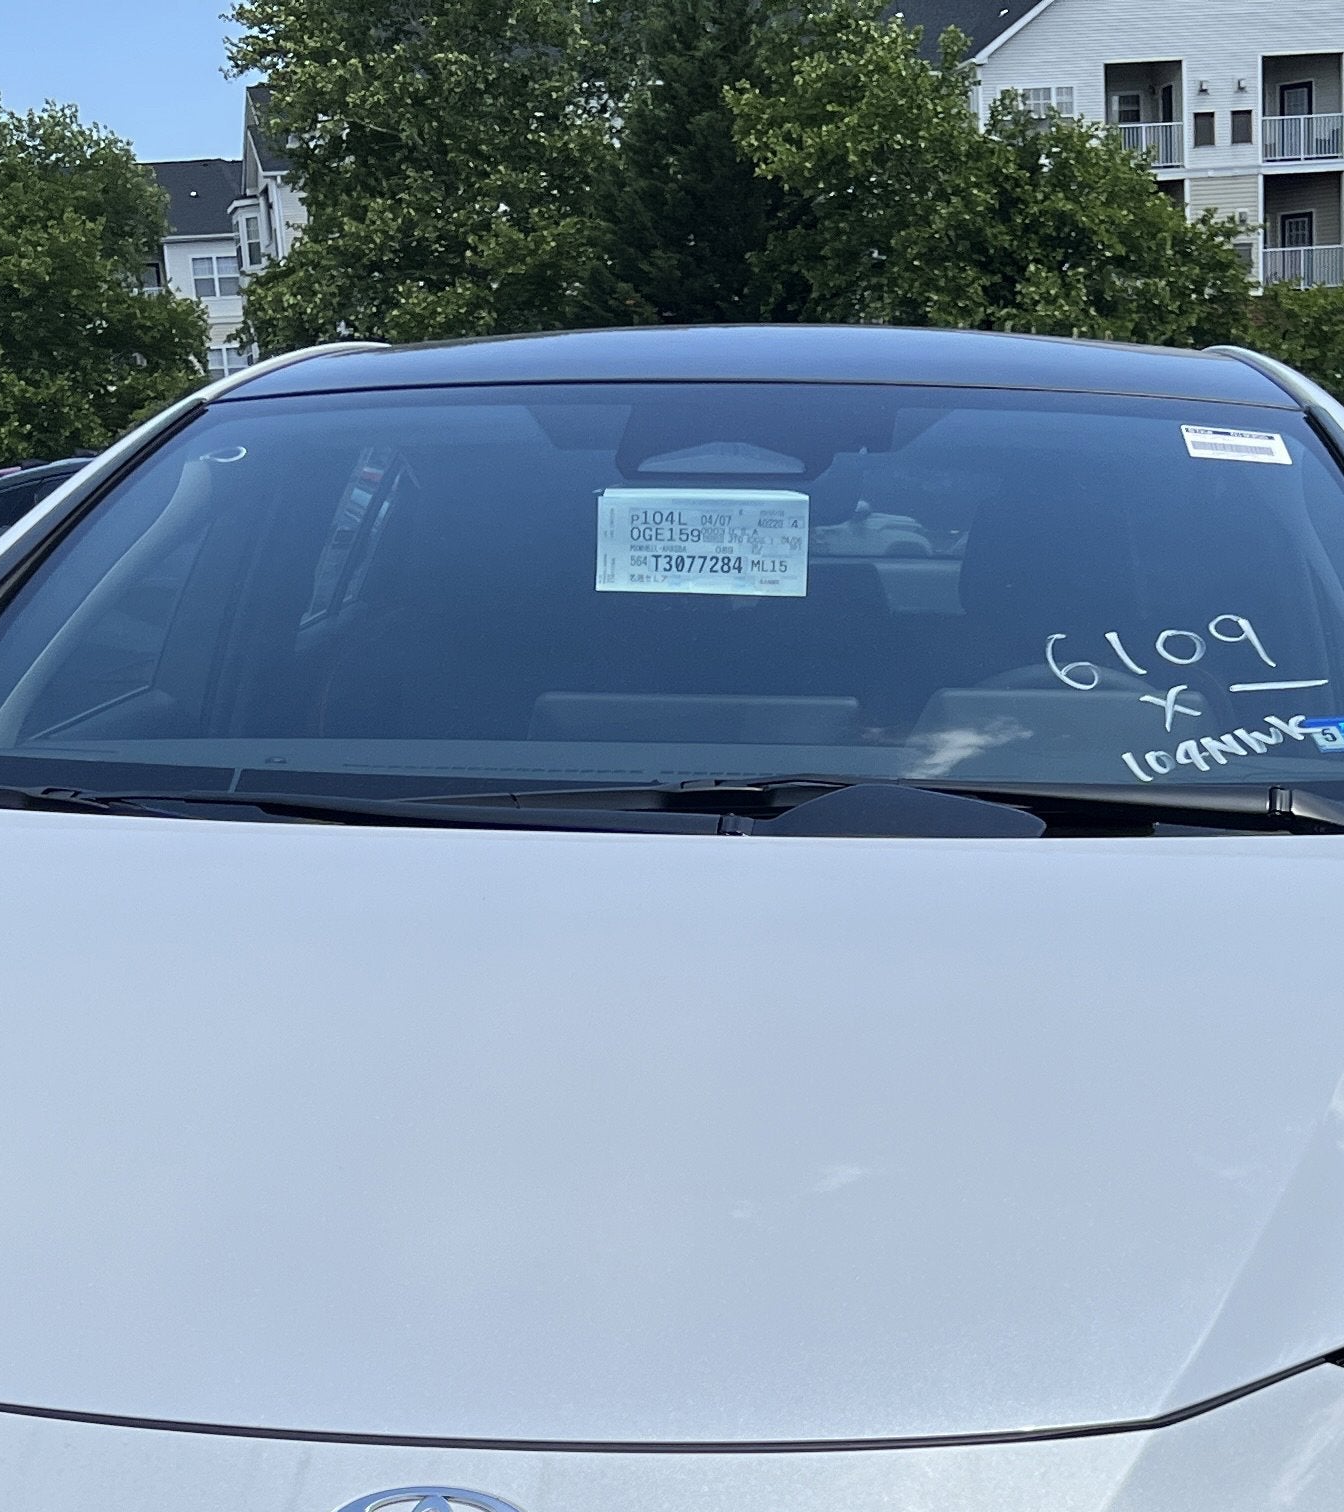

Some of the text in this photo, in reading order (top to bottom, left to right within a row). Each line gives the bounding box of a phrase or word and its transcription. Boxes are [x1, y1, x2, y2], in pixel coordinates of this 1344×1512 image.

[650, 554, 743, 574] T3077284
[751, 559, 788, 573] ML15
[1045, 613, 1277, 691] 6109
